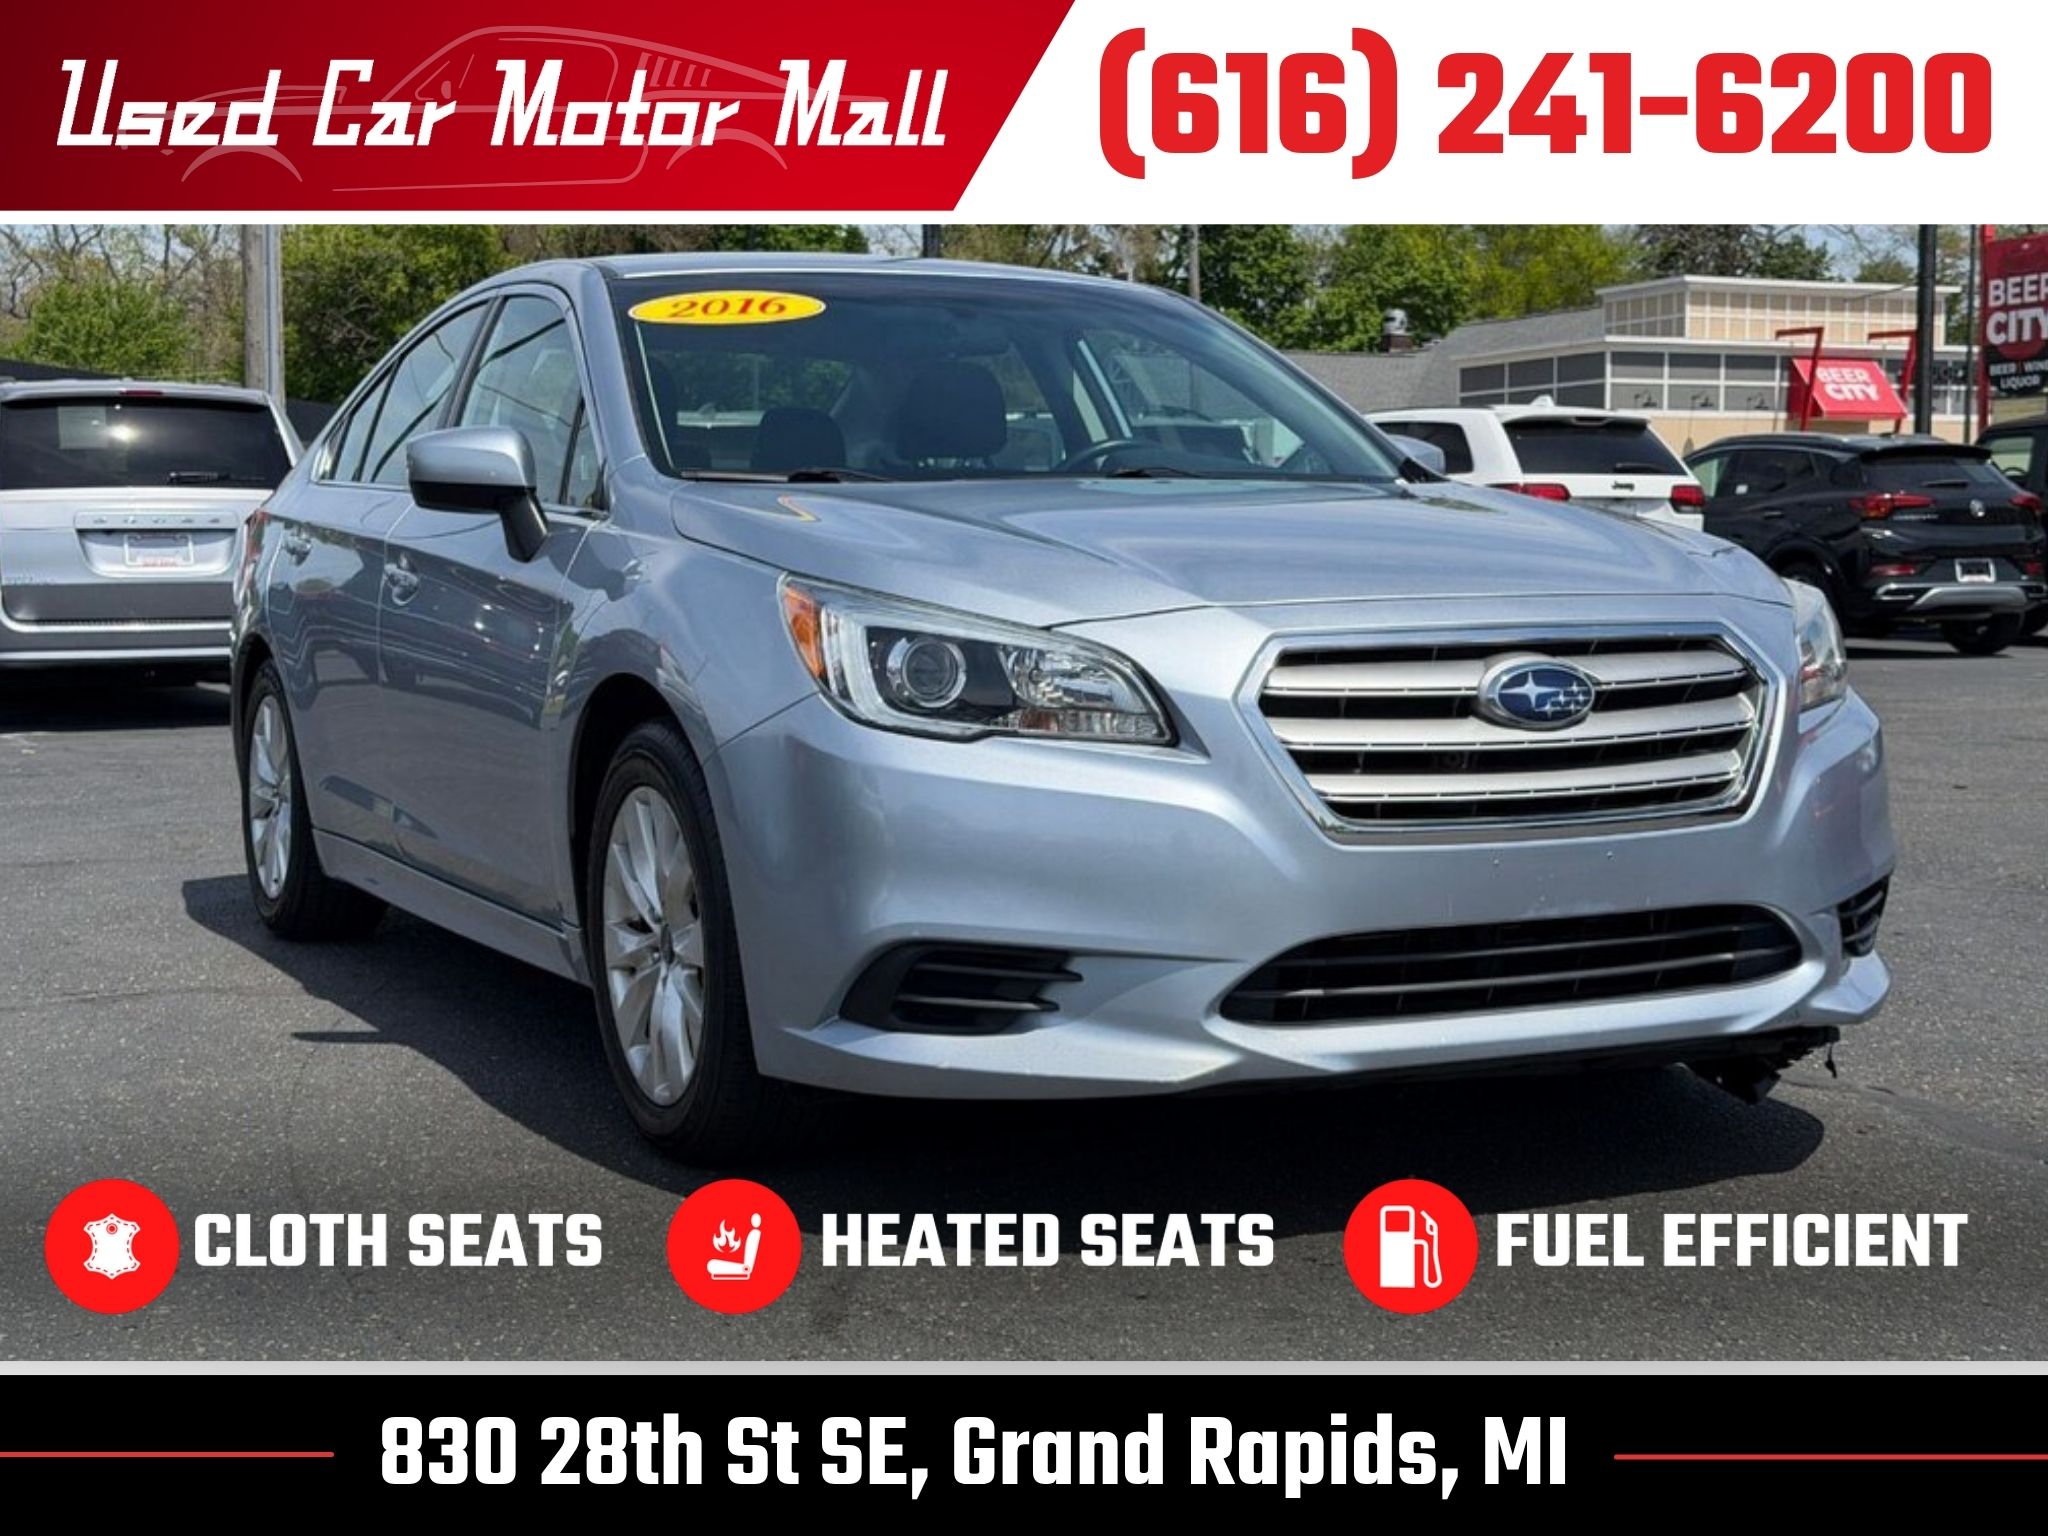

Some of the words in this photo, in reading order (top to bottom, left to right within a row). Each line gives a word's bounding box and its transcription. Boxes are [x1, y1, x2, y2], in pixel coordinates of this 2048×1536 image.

[669, 298, 787, 318] 2016
[1816, 368, 1870, 384] BEER
[2001, 375, 2040, 389] LIQUOR
[1825, 384, 1880, 401] CITY
